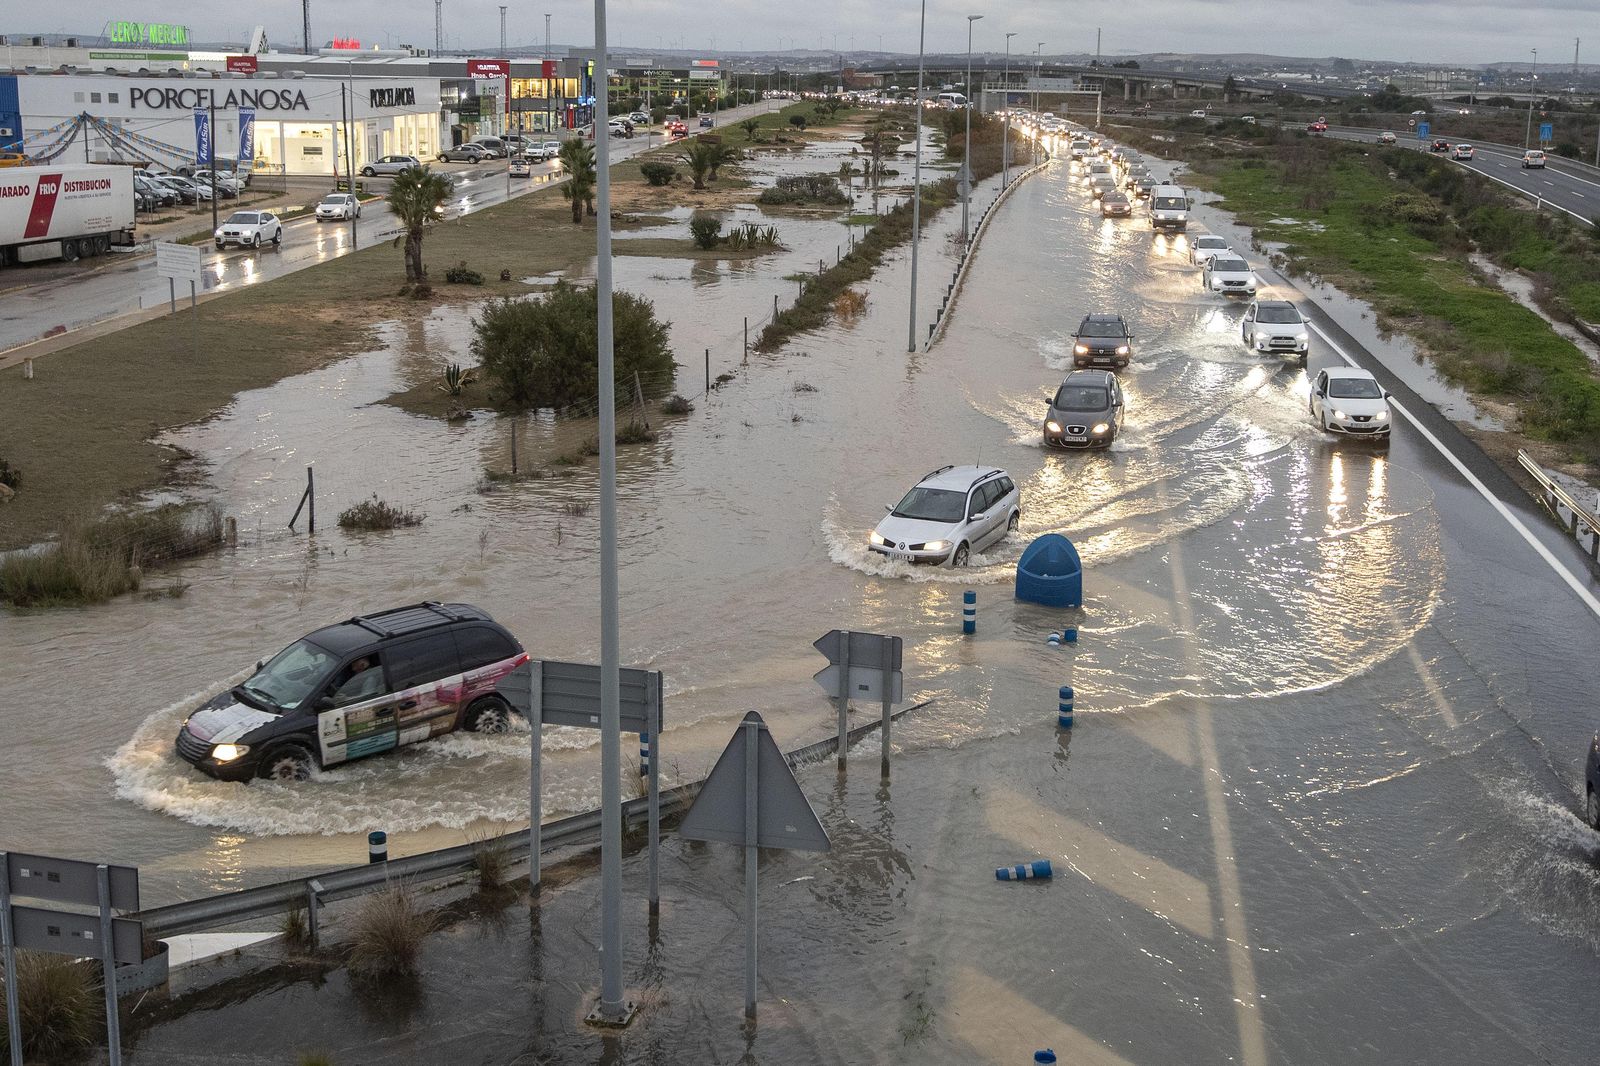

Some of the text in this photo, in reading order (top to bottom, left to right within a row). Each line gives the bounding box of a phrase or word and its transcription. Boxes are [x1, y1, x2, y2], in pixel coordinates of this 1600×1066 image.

[111, 21, 188, 45] LEROY MERLIN
[130, 87, 310, 111] PORCELANOSA
[39, 183, 57, 195] FRIO
[64, 178, 112, 193] DISTRIBUCION
